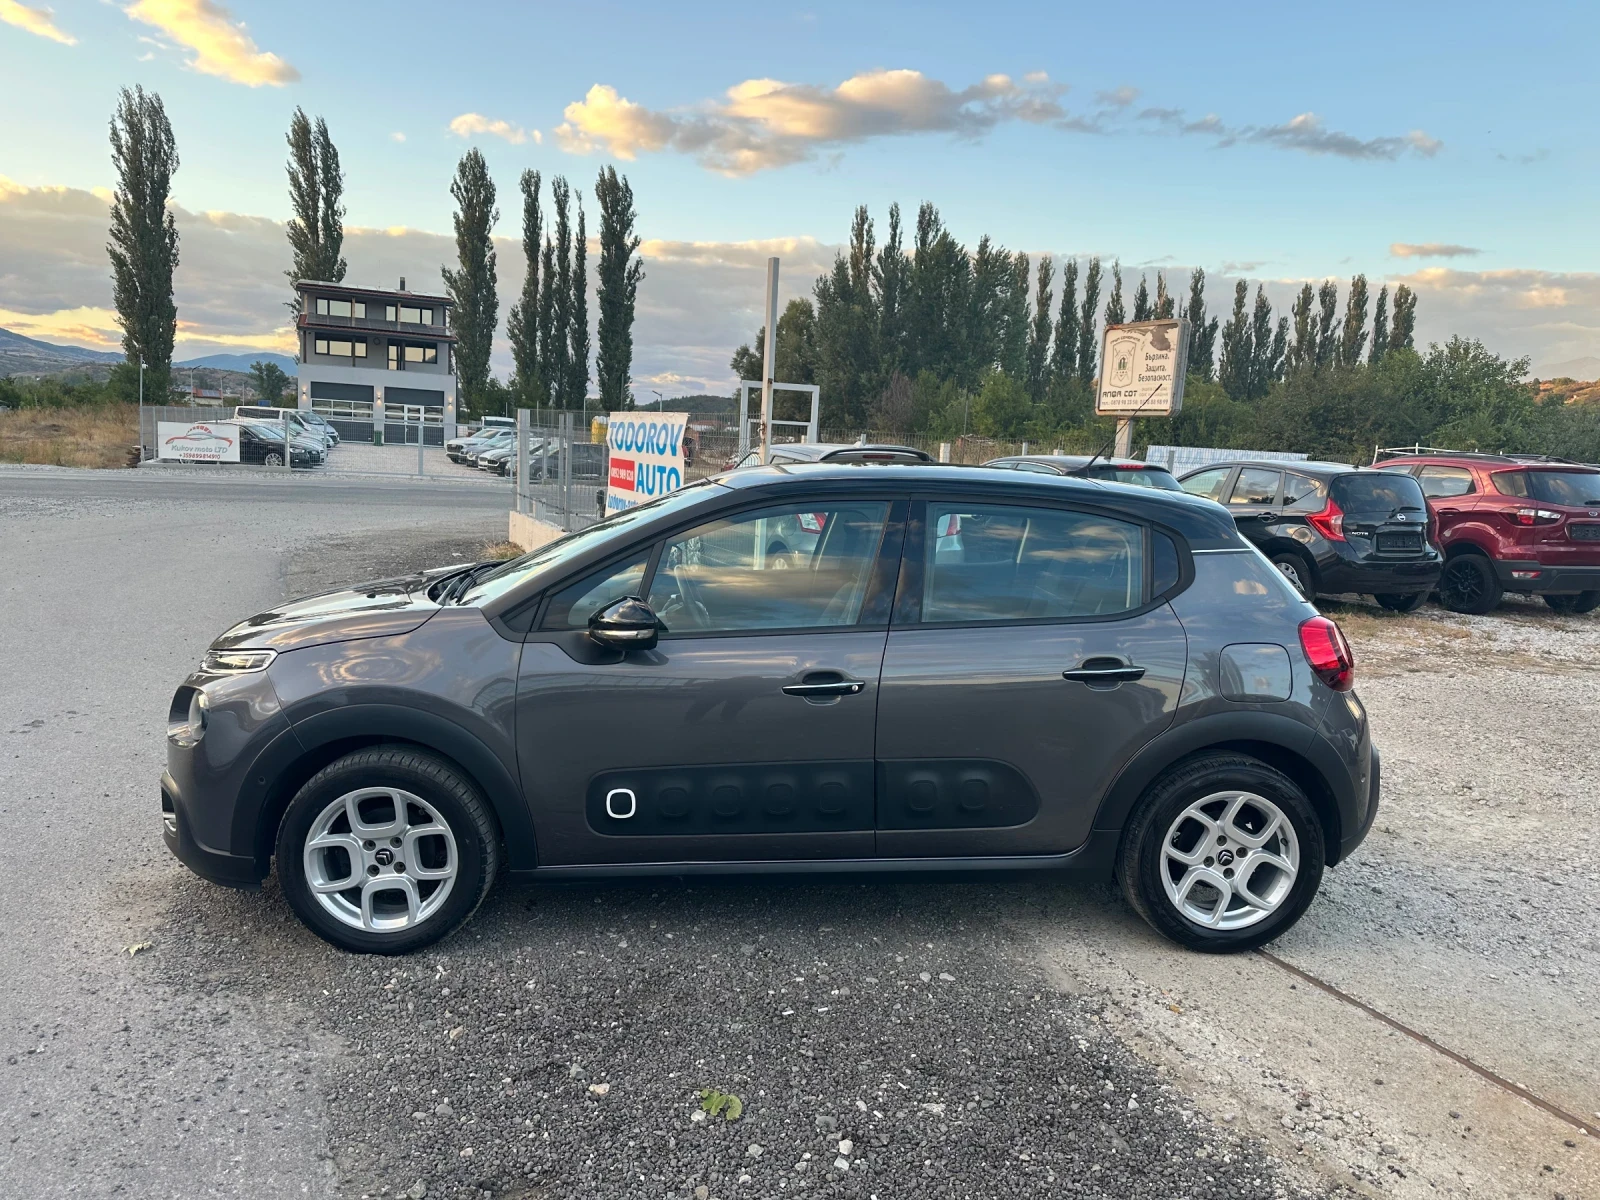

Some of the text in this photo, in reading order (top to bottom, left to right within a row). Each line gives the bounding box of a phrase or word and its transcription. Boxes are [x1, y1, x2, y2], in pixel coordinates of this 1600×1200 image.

[1145, 353, 1169, 362] Бързина.
[1145, 364, 1167, 373] Защита.
[1138, 374, 1172, 382] Безопасност.
[610, 422, 683, 456] TODOROV
[194, 445, 213, 453] moto
[214, 446, 228, 454] LTD
[636, 463, 680, 495] AUTO
